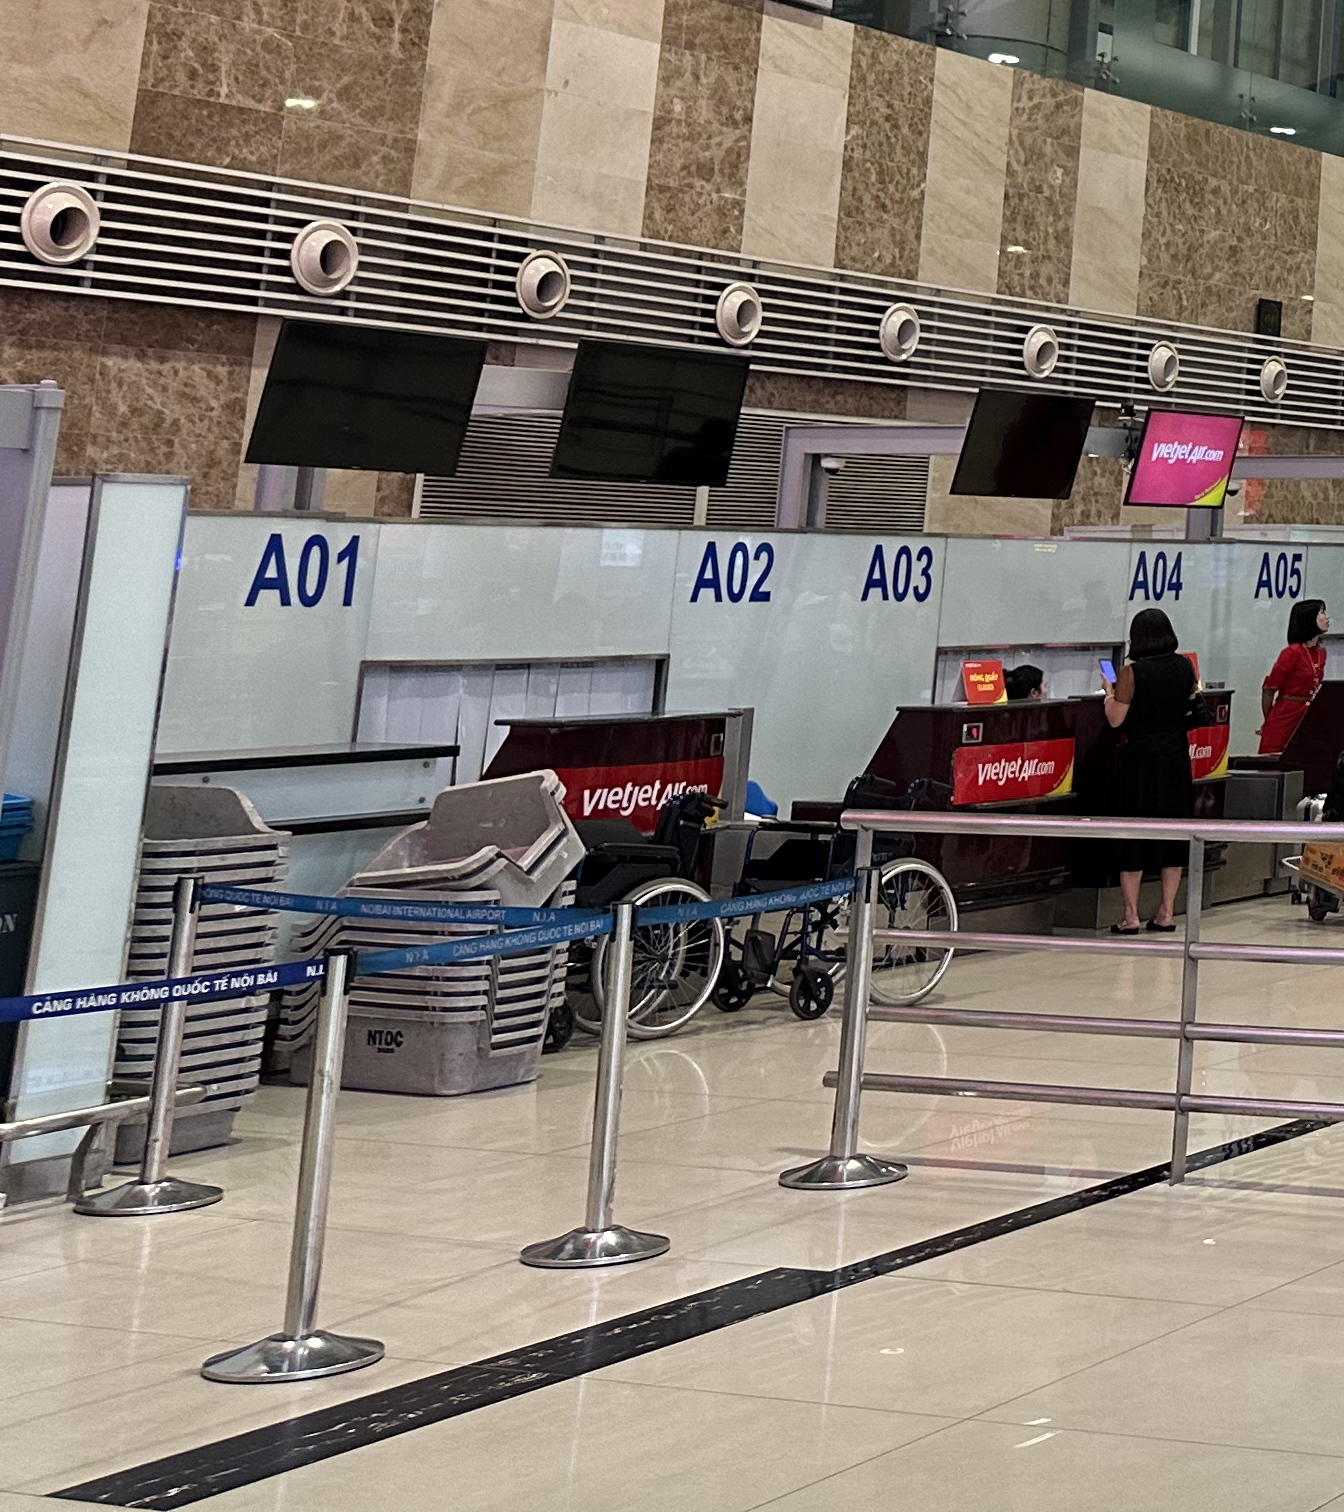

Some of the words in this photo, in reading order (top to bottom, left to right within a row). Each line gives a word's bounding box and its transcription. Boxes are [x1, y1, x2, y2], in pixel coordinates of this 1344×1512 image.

[244, 533, 361, 607] A01
[690, 541, 775, 603] A02
[862, 545, 932, 602] A03
[1129, 551, 1182, 600] A04
[1254, 552, 1302, 599] A05
[391, 905, 466, 920] INTERNATIONAL
[466, 908, 506, 921] AIRPORT
[31, 997, 73, 1014] CẢNG
[76, 990, 117, 1010] HÀNG
[121, 983, 170, 1003] KHÔNG
[172, 976, 210, 997] QUỐC
[212, 974, 230, 991] TẾ
[231, 972, 255, 990] NỘI
[257, 969, 278, 985] BÀI
